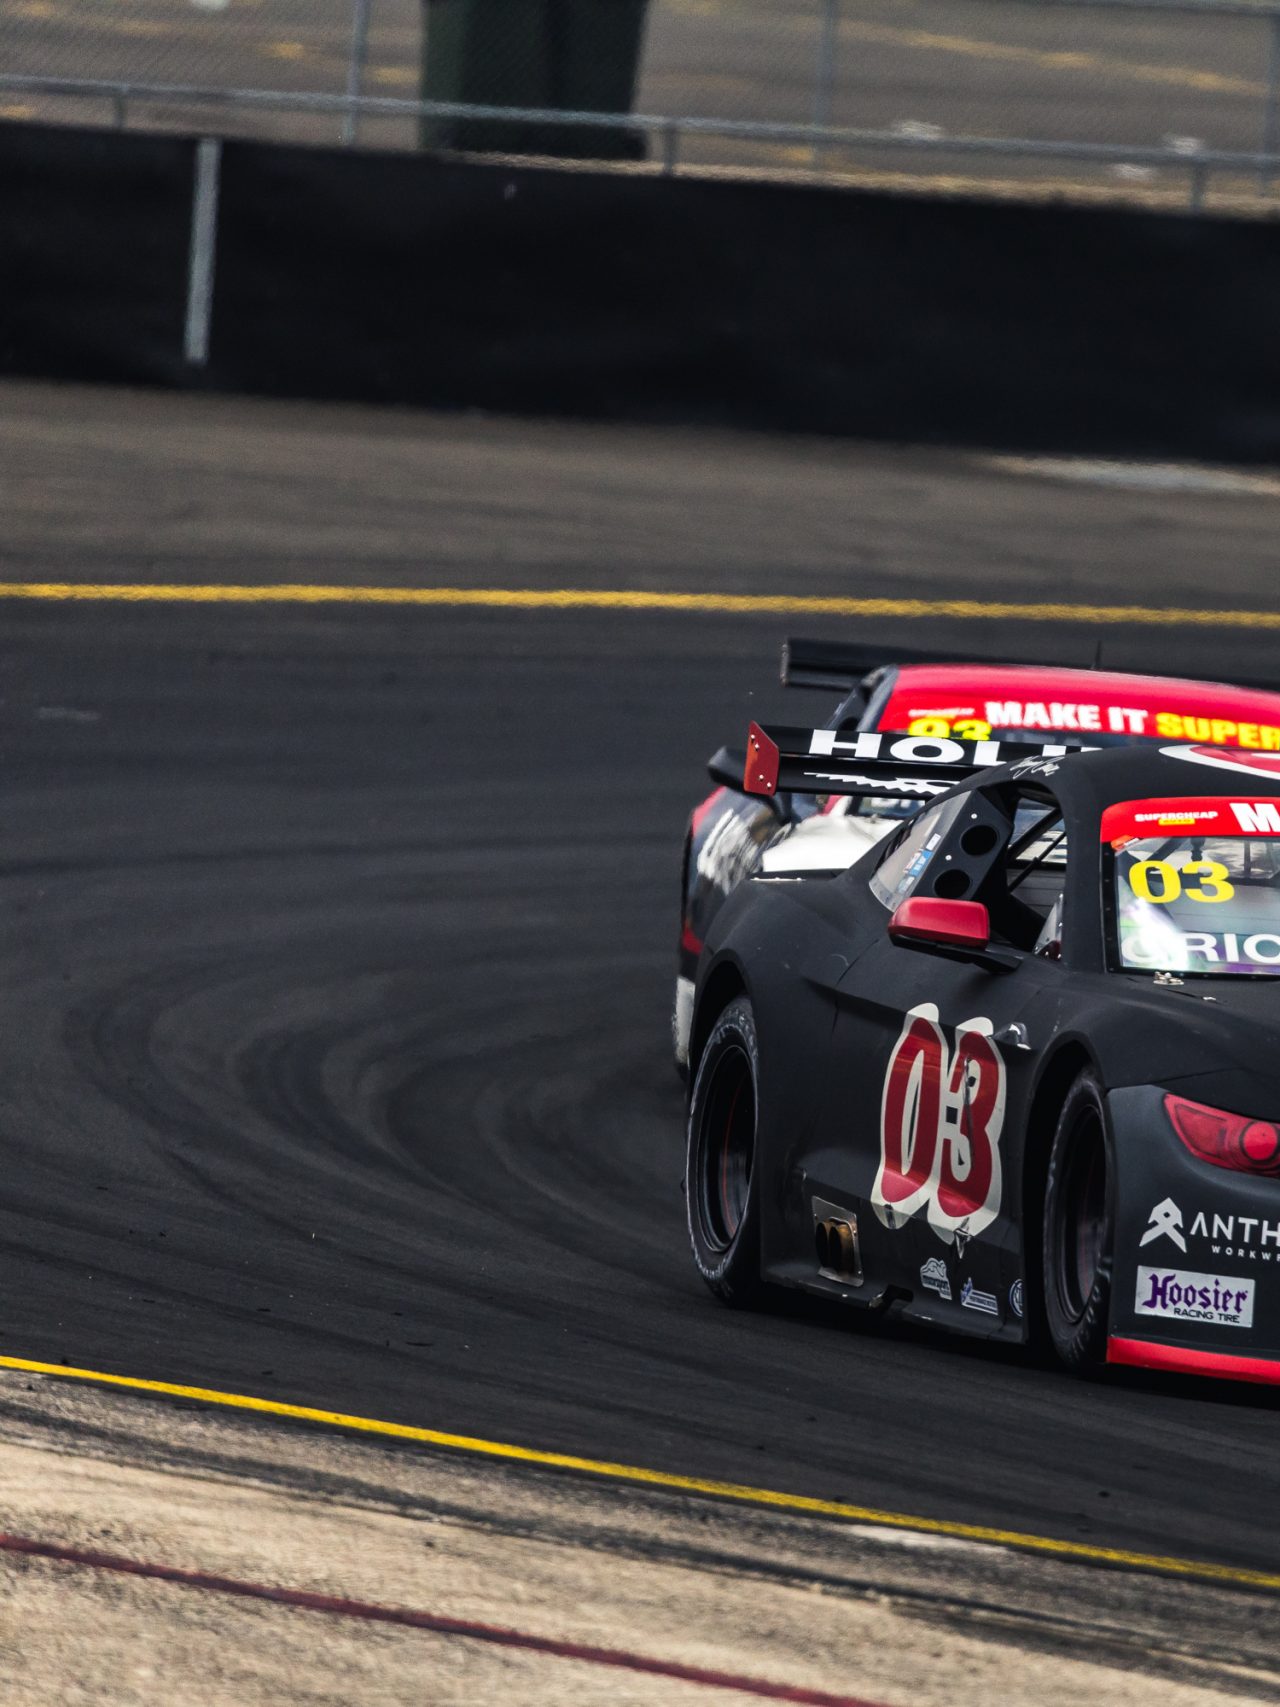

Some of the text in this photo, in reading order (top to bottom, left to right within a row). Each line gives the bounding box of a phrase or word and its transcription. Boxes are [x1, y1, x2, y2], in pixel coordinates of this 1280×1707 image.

[985, 702, 1101, 730] MAKE
[1108, 706, 1148, 733] IT
[1134, 811, 1218, 822] SUPERCHEAP
[1128, 860, 1236, 903] 03
[876, 1010, 1003, 1228] 03
[1142, 1273, 1248, 1314] Hoosier
[1173, 1307, 1240, 1324] RACING TIRE
